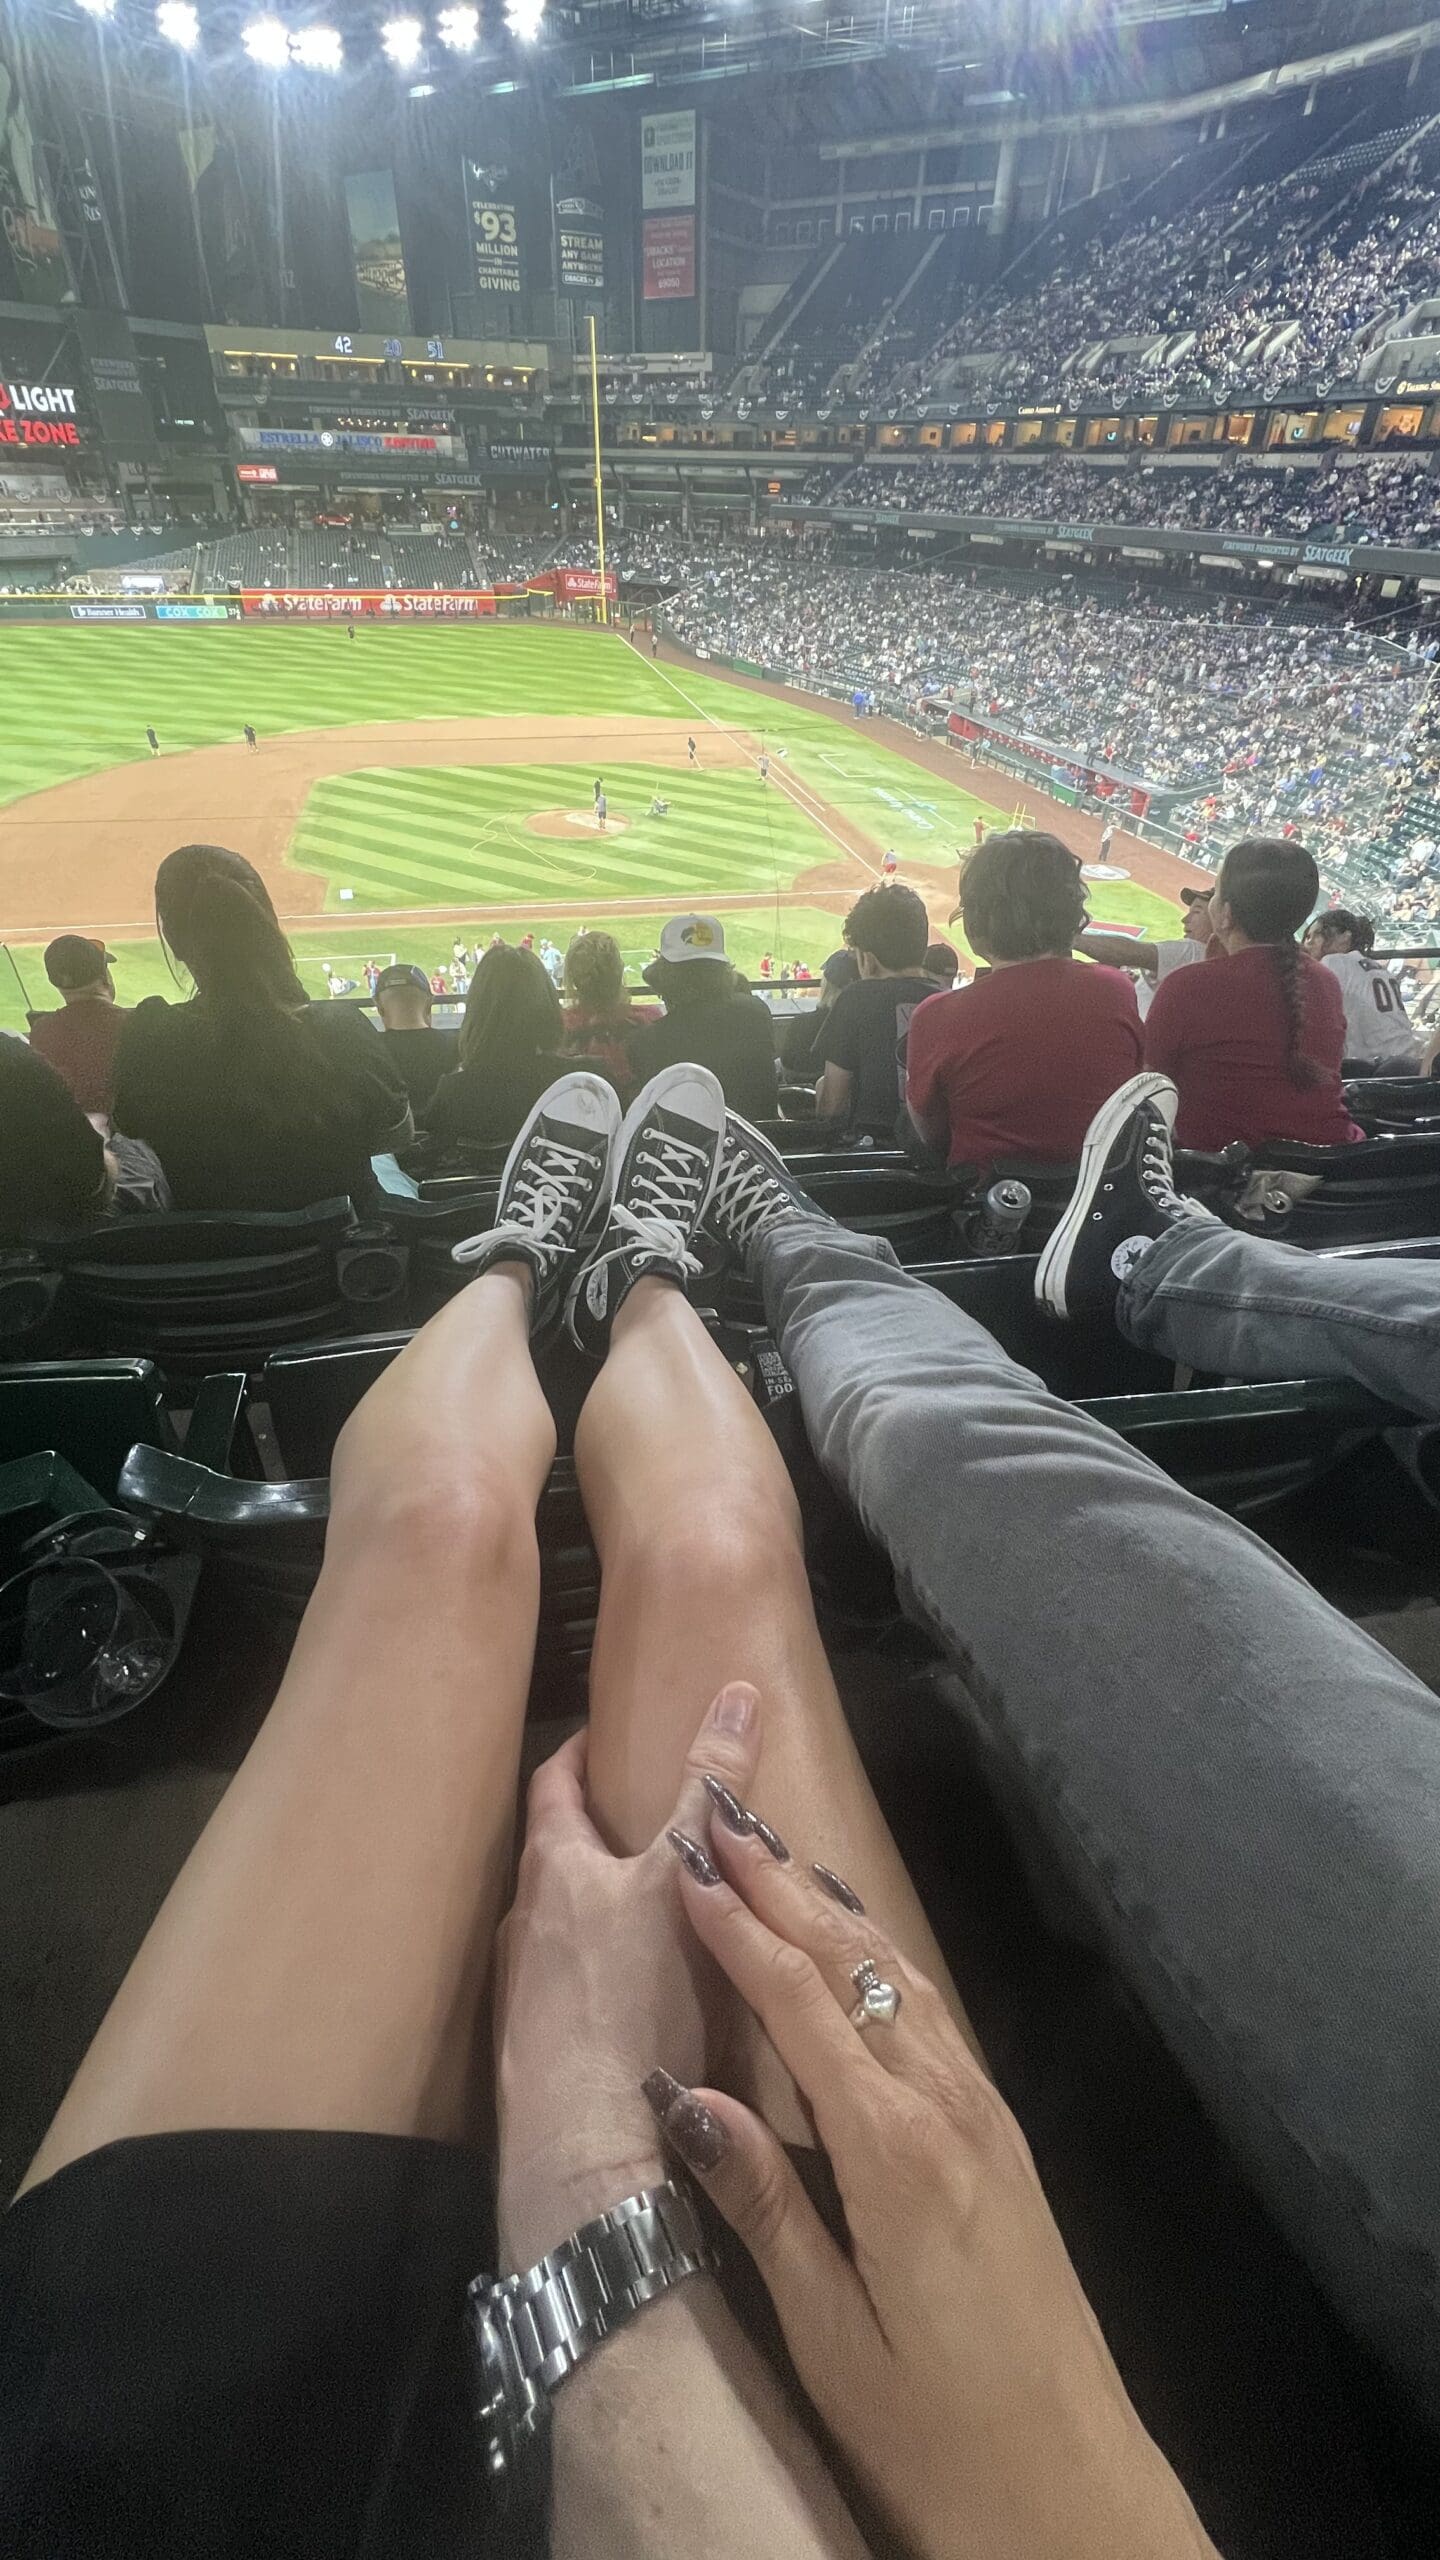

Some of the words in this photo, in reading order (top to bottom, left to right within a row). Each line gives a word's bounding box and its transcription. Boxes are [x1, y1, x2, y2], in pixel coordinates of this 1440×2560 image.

[476, 241, 518, 257] MILLION
[560, 235, 603, 250] STREAM
[561, 249, 579, 260] ANY
[479, 276, 521, 292] GIVING
[335, 335, 353, 354] 42
[427, 341, 444, 359] 51
[8, 384, 77, 413] LIGHT
[20, 420, 80, 446] ZONE
[259, 431, 319, 446] ESTRELLA
[1303, 544, 1353, 566] SEATGEEK
[767, 1383, 793, 1396] FOO
